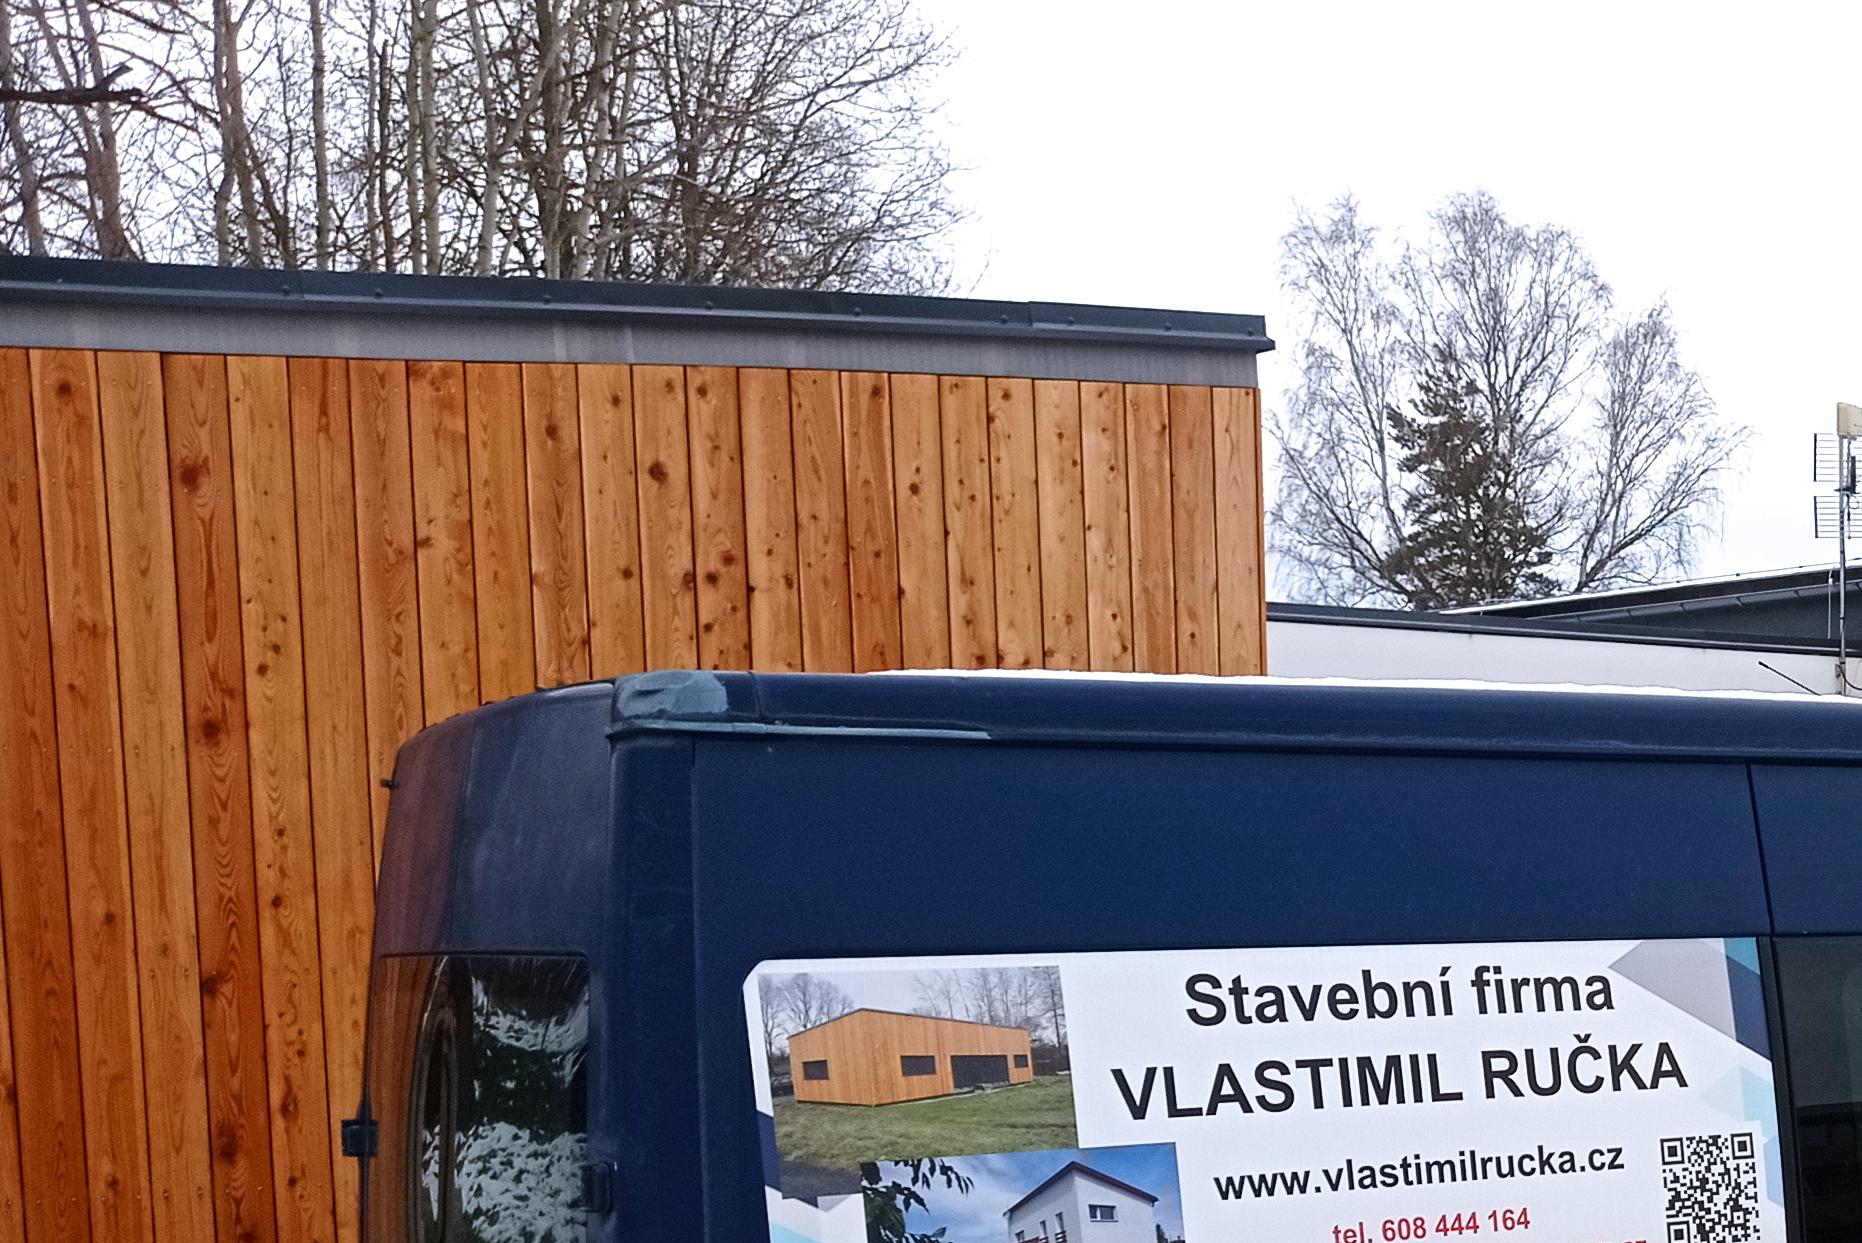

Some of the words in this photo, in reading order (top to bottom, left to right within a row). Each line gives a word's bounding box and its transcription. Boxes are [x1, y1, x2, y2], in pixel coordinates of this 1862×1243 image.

[1186, 966, 1451, 1026] Stavební
[1466, 966, 1614, 1018] firma
[1111, 1053, 1463, 1120] VLASTIMIL
[1482, 1033, 1688, 1099] RUČKA
[1214, 1145, 1625, 1200] www.vlastimilrucka.cz
[1382, 1217, 1427, 1242] 608
[1435, 1212, 1480, 1237] 444
[1488, 1208, 1531, 1232] 164
